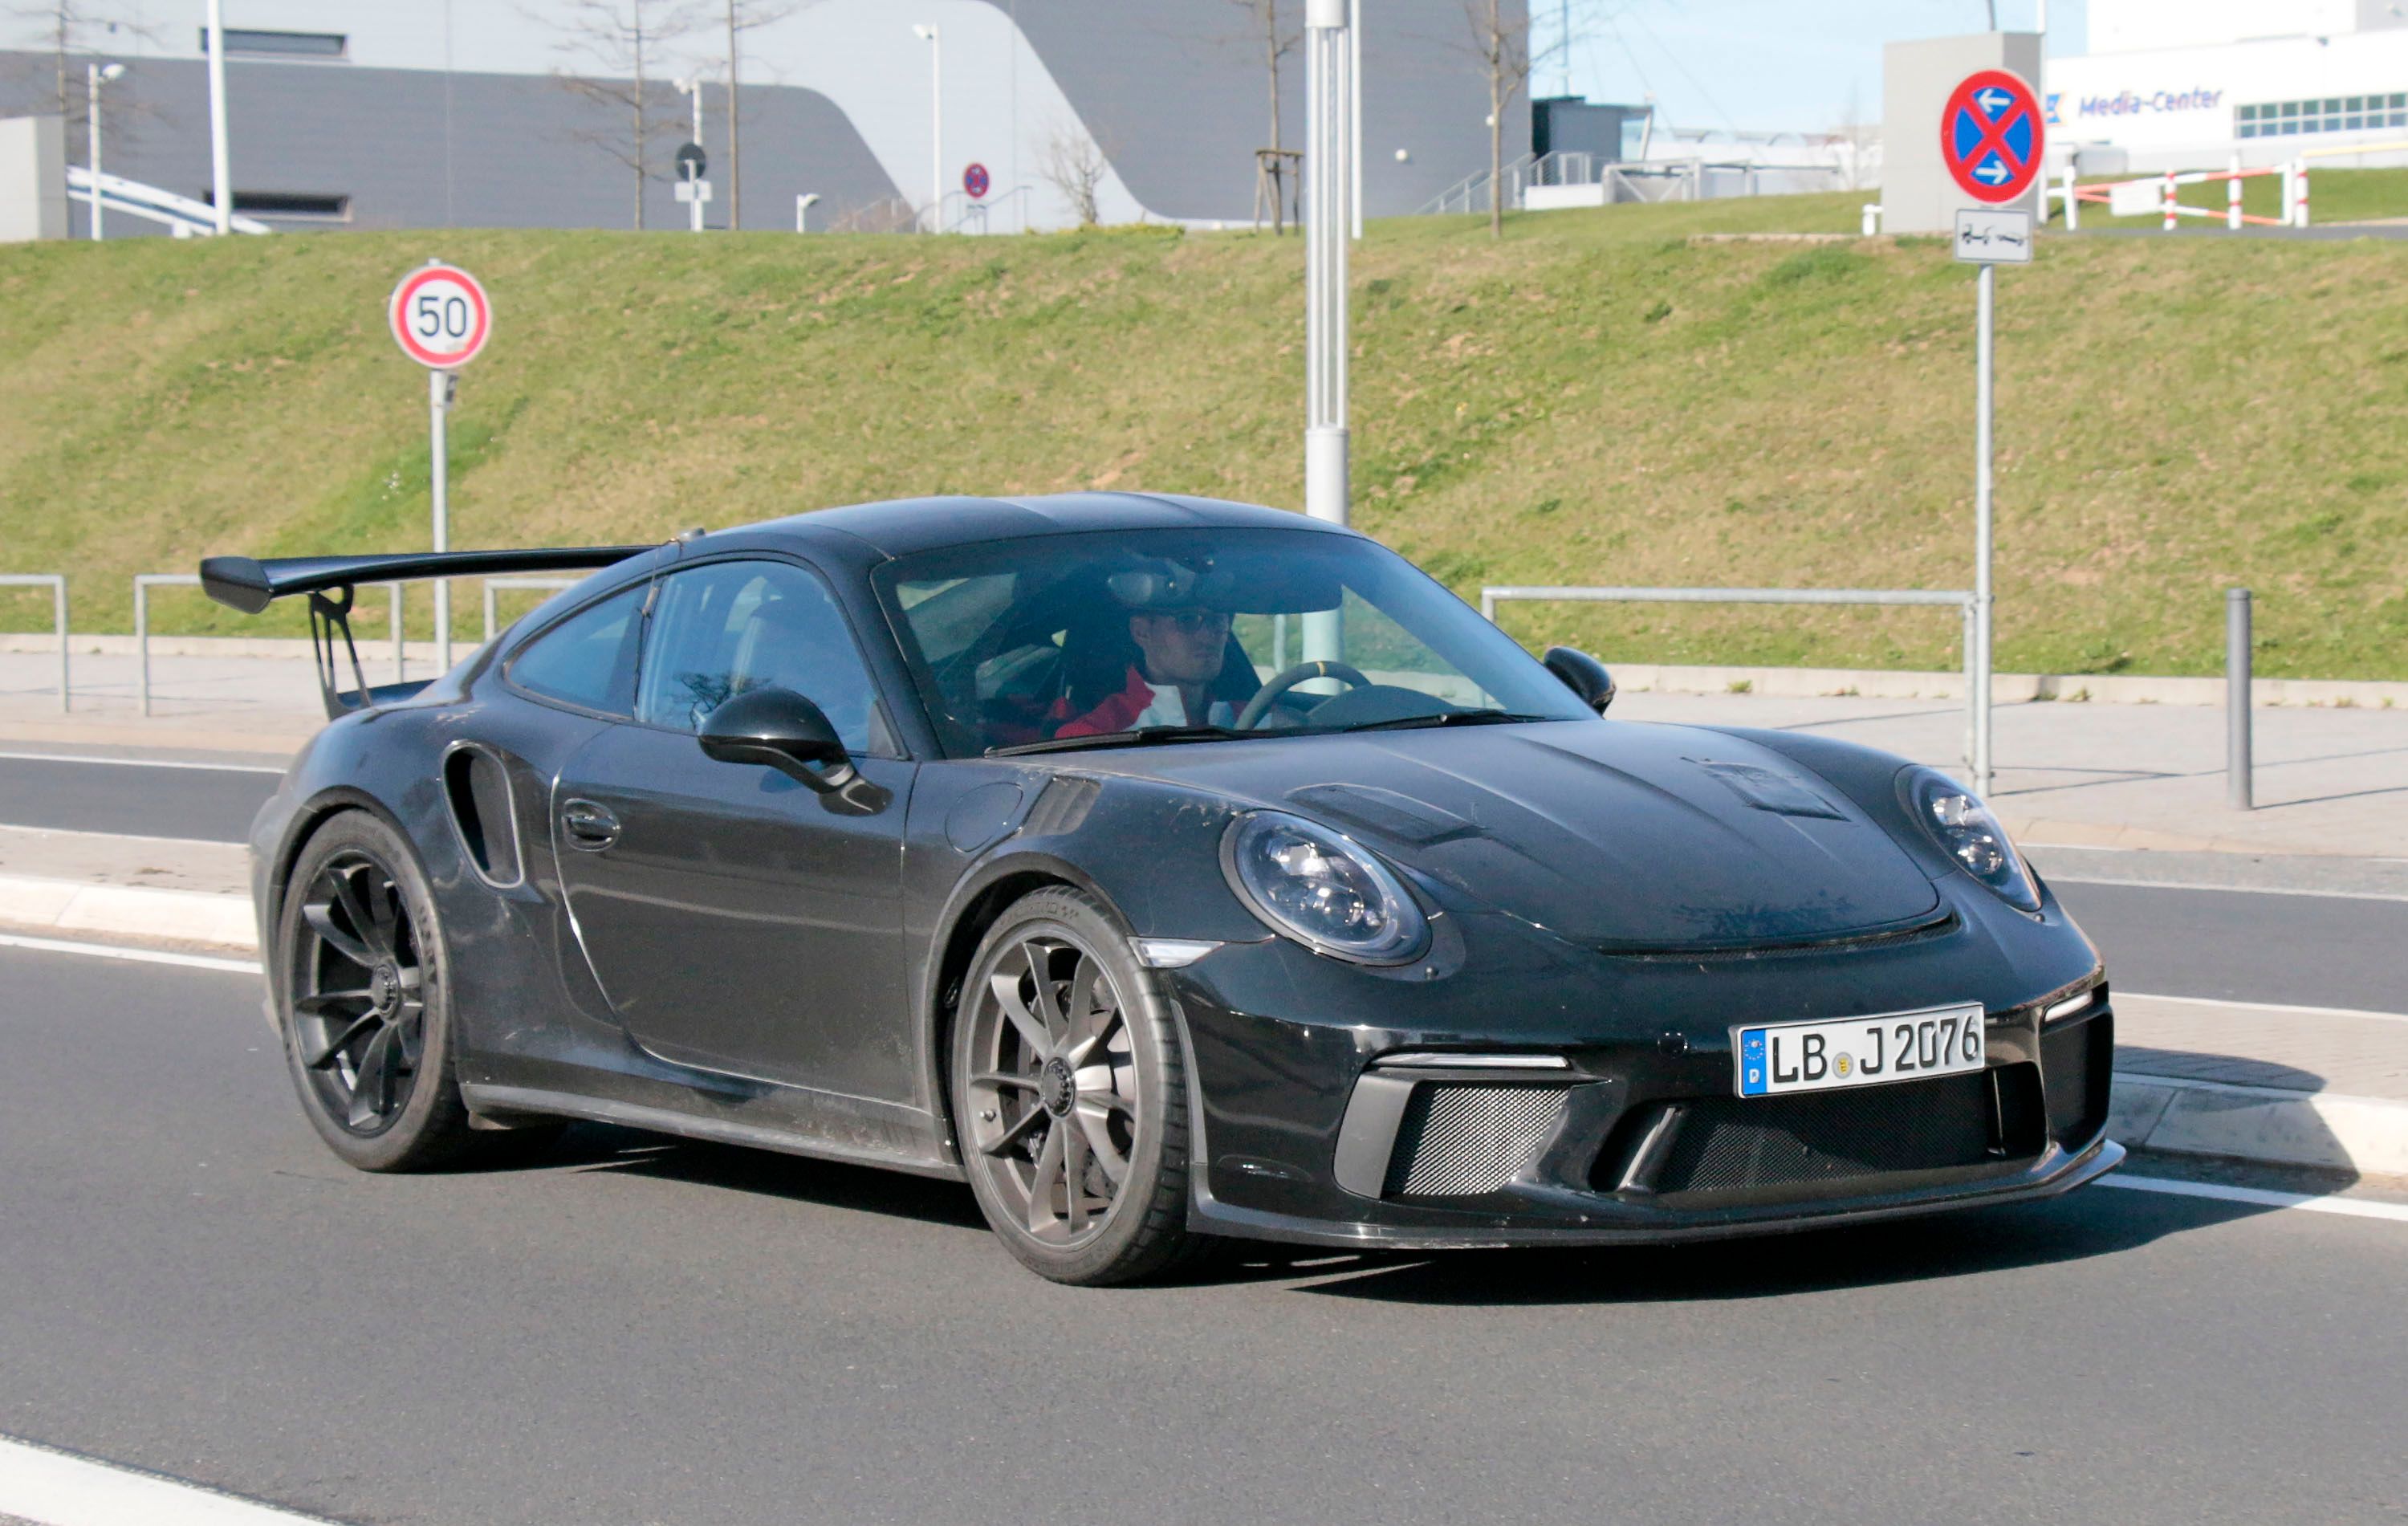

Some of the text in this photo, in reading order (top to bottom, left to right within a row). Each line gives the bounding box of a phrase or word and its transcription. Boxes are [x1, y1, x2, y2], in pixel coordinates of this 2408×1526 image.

[2079, 86, 2223, 117] Media-Center
[418, 295, 467, 338] 50
[1772, 1015, 1979, 1084] LB J 2076
[1748, 1068, 1760, 1084] D
